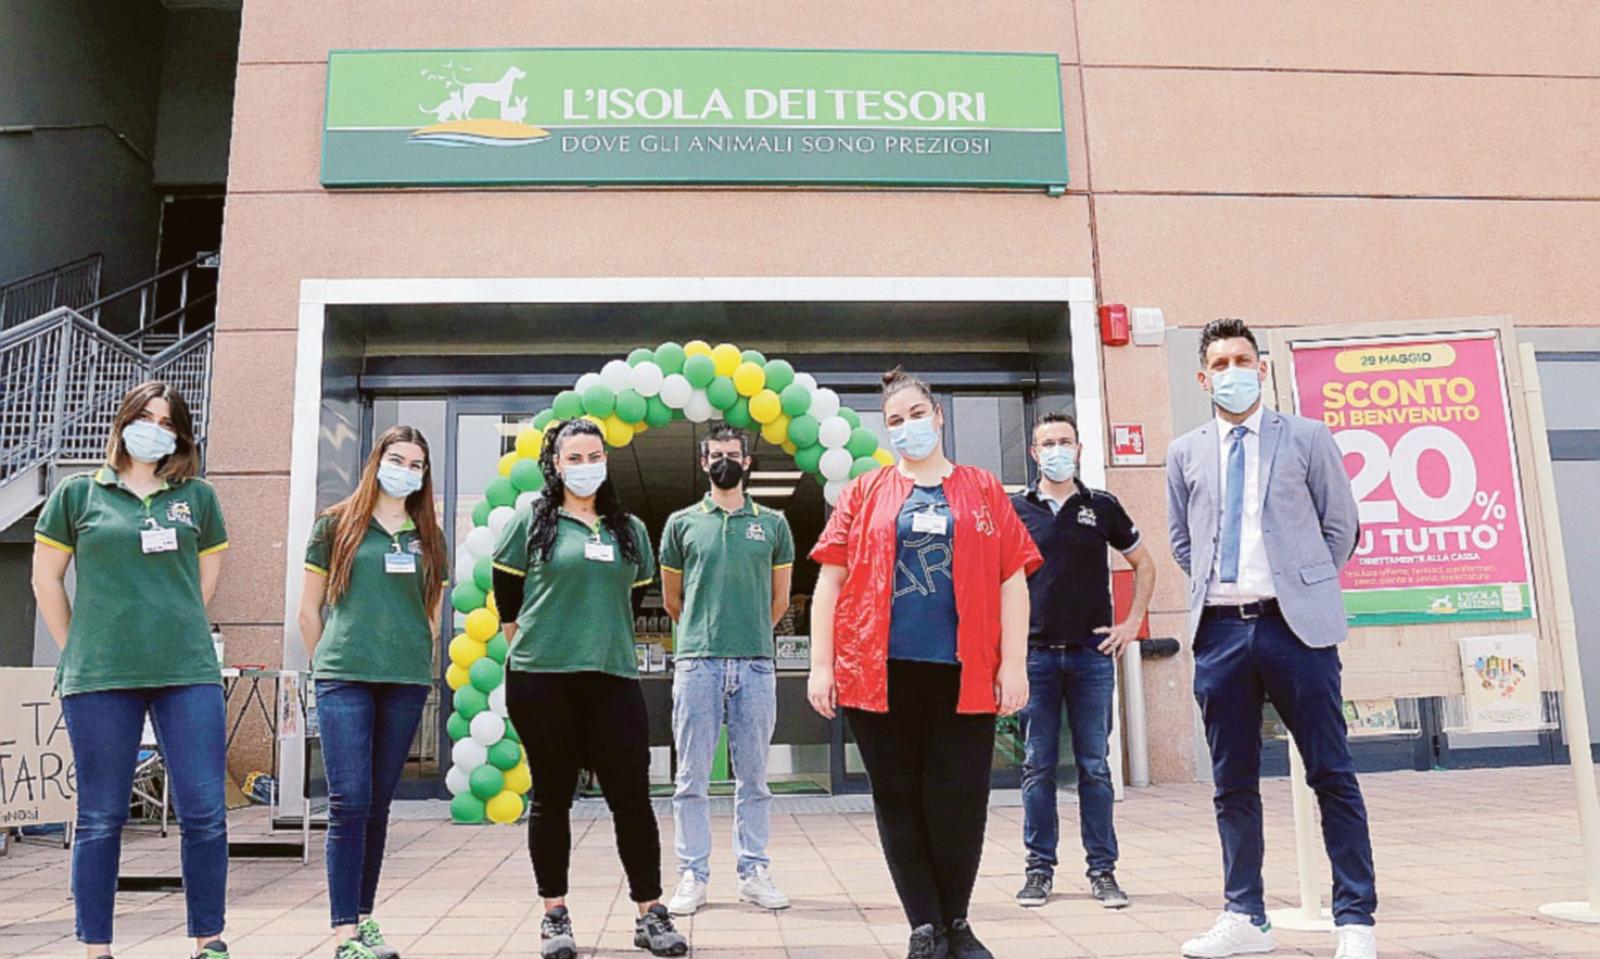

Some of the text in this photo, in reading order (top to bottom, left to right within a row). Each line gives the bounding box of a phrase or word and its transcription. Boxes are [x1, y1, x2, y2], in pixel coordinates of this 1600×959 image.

[563, 88, 986, 122] L'ISOLA DEI TESORI
[561, 135, 990, 154] DOVE GLI ANIMALI SONO PREZIOSI
[1360, 352, 1432, 366] 29 MAGGIO
[1322, 377, 1475, 409] SCONTO
[1324, 405, 1480, 427] DI BENVENUTO
[1355, 528, 1376, 556] U
